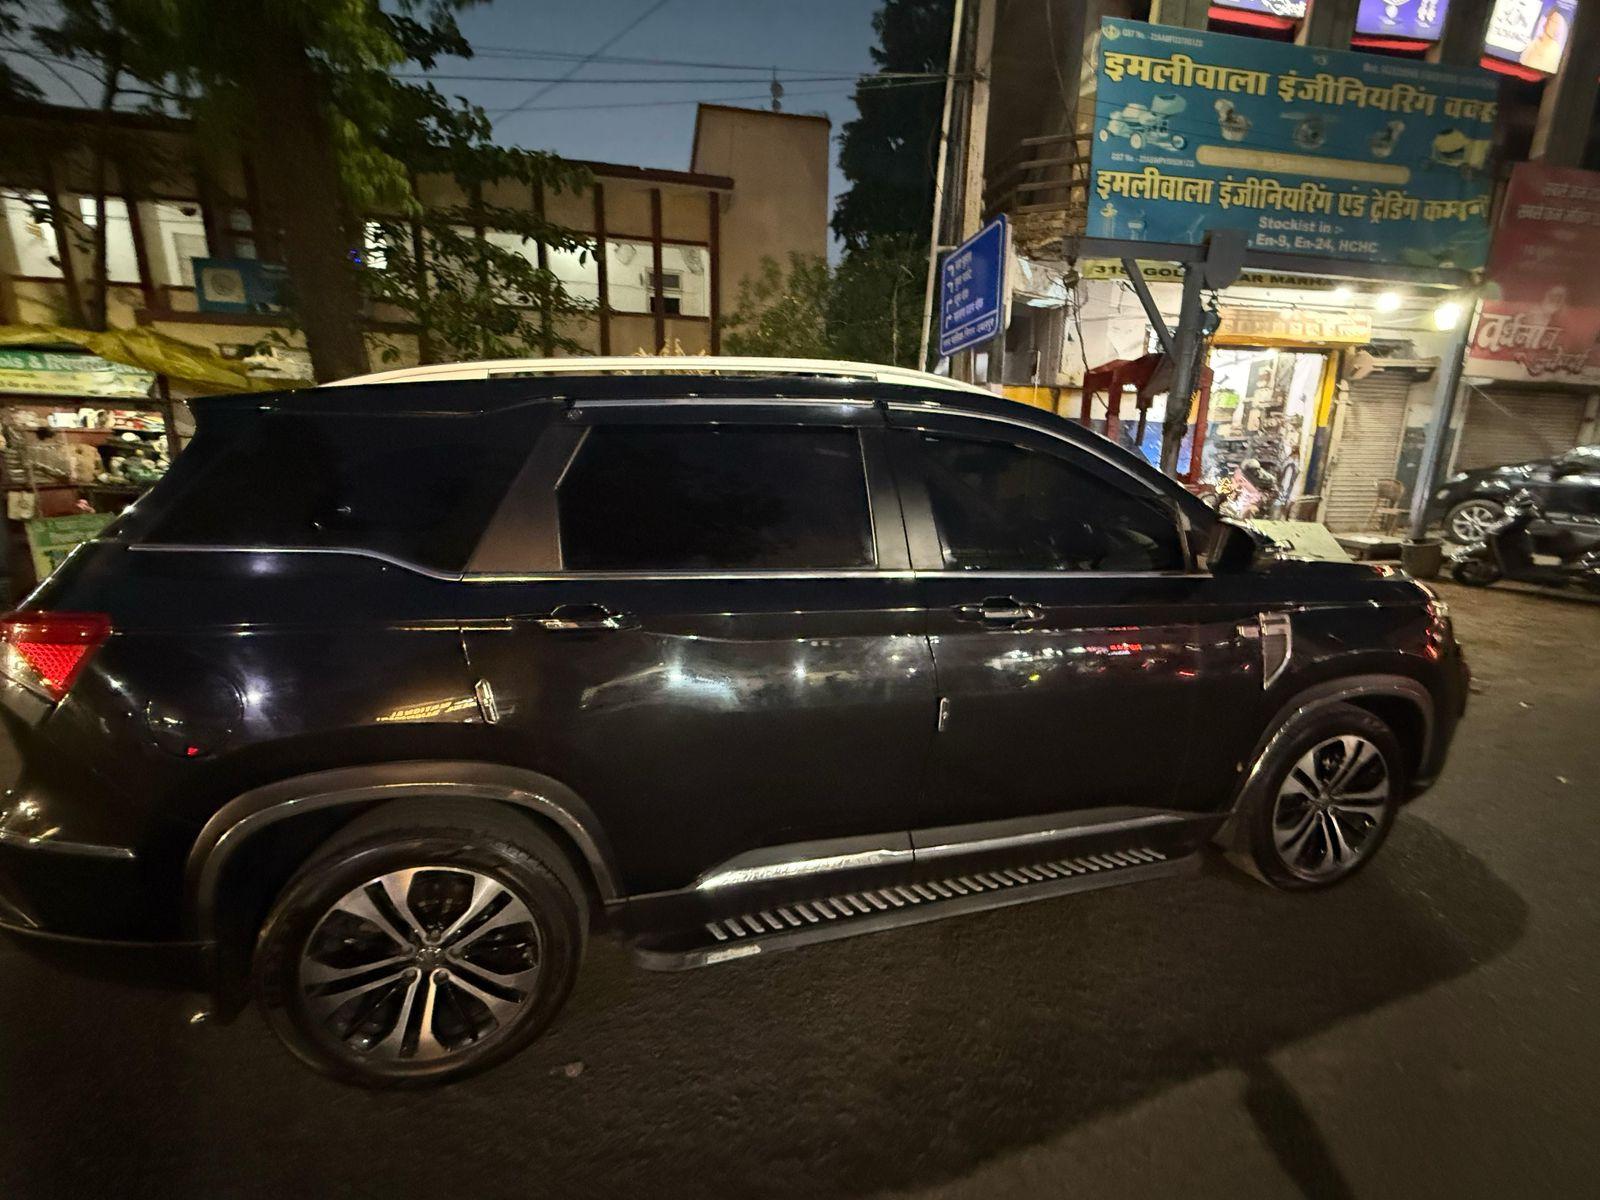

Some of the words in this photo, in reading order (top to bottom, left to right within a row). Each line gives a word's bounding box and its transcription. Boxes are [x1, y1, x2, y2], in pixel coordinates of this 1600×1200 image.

[1103, 49, 1268, 97] इमलीवाला
[1277, 69, 1437, 117] इंजीनियरिंग
[1097, 166, 1214, 204] इमलीवाला
[1219, 176, 1332, 215] इंजीनियरिंग
[1371, 188, 1418, 224] ट्रेडिंग
[1258, 215, 1317, 232] Stockist
[1318, 220, 1331, 233] in
